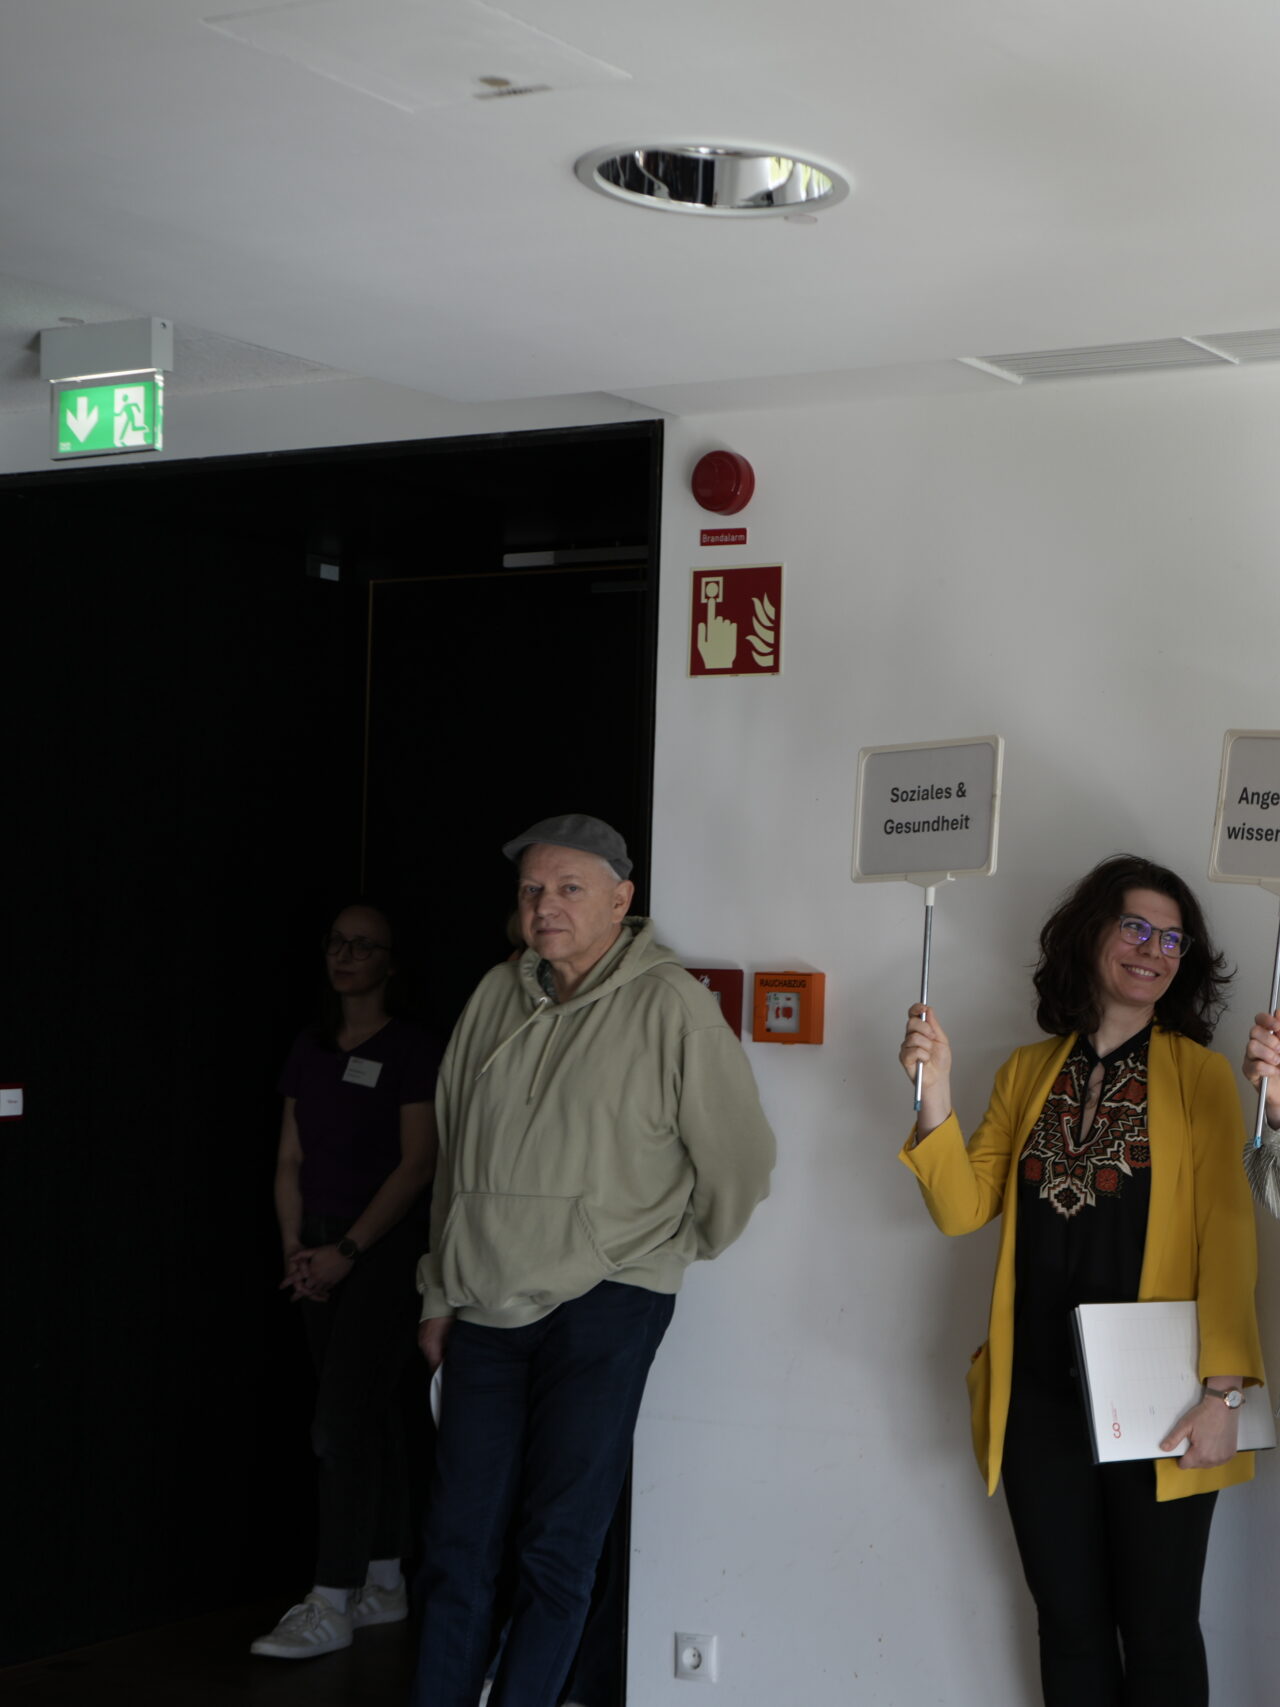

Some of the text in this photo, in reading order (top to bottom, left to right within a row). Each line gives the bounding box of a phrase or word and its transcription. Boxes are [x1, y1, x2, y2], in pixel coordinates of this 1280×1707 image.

[702, 533, 745, 543] Brandalarm
[890, 781, 967, 803] Soziales &
[884, 813, 970, 835] Gesundheit
